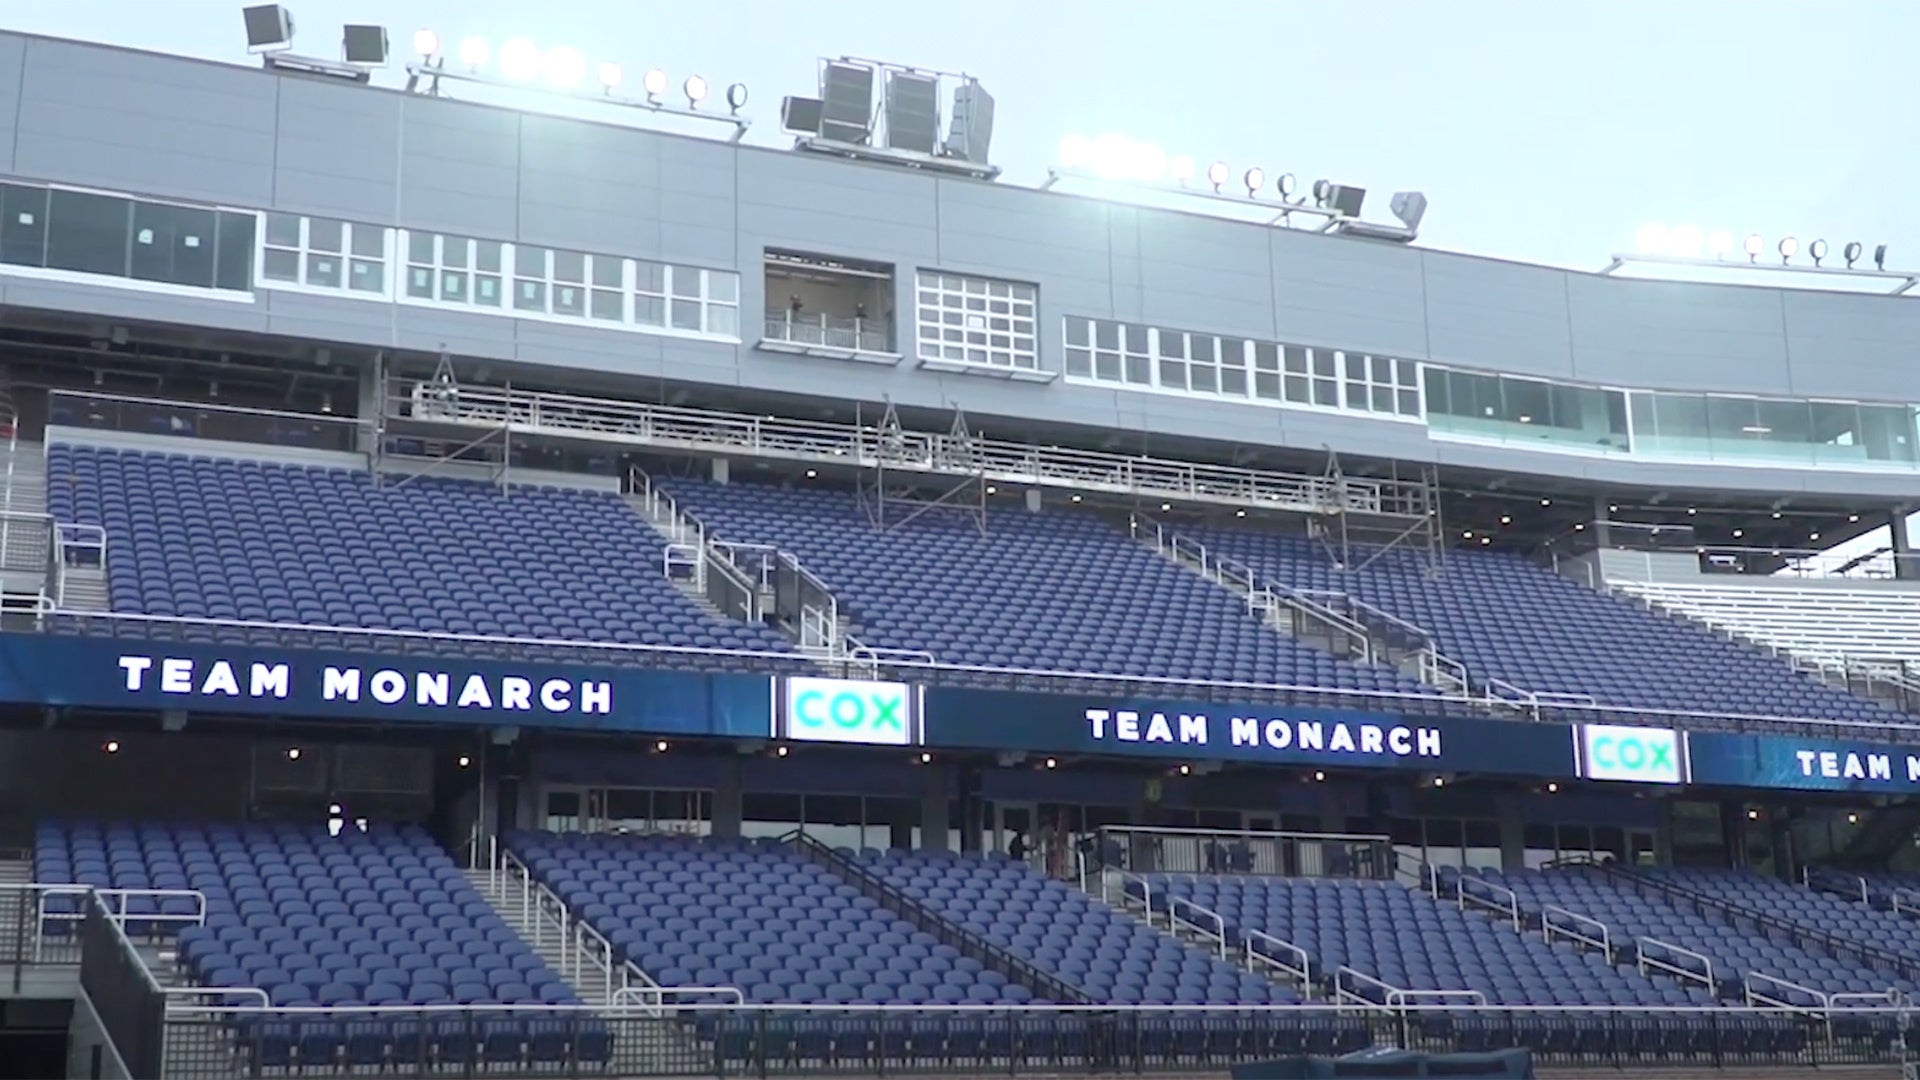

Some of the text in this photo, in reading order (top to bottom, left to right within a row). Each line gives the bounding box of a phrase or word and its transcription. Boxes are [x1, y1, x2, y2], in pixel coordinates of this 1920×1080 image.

[118, 656, 610, 714] TEAM MONARCH
[795, 690, 900, 729] COX
[1085, 709, 1441, 756] TEAM MONARCH
[1592, 736, 1673, 771] COX
[1796, 750, 1891, 780] TEAM
